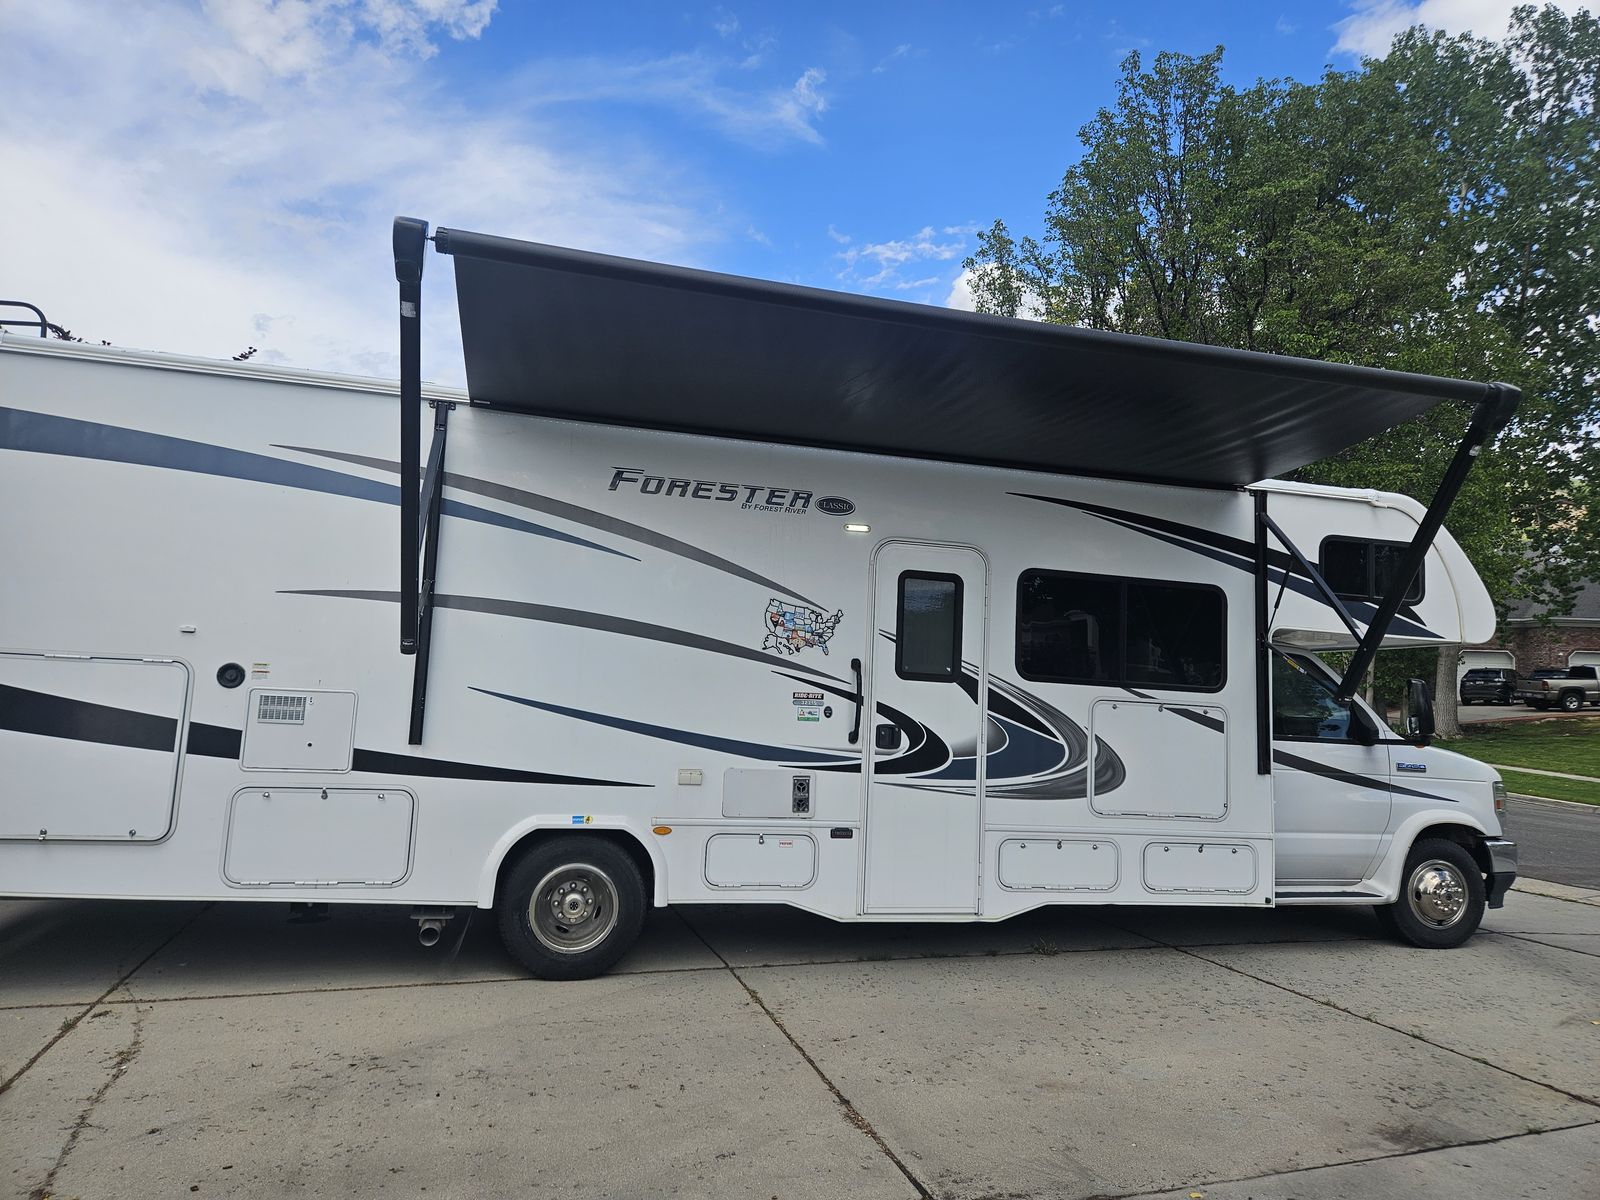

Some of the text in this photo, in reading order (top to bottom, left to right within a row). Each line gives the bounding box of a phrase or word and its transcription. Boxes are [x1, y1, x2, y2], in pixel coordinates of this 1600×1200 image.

[608, 466, 814, 509] FORESTER
[754, 503, 783, 513] FOREST
[785, 506, 807, 515] RIVER
